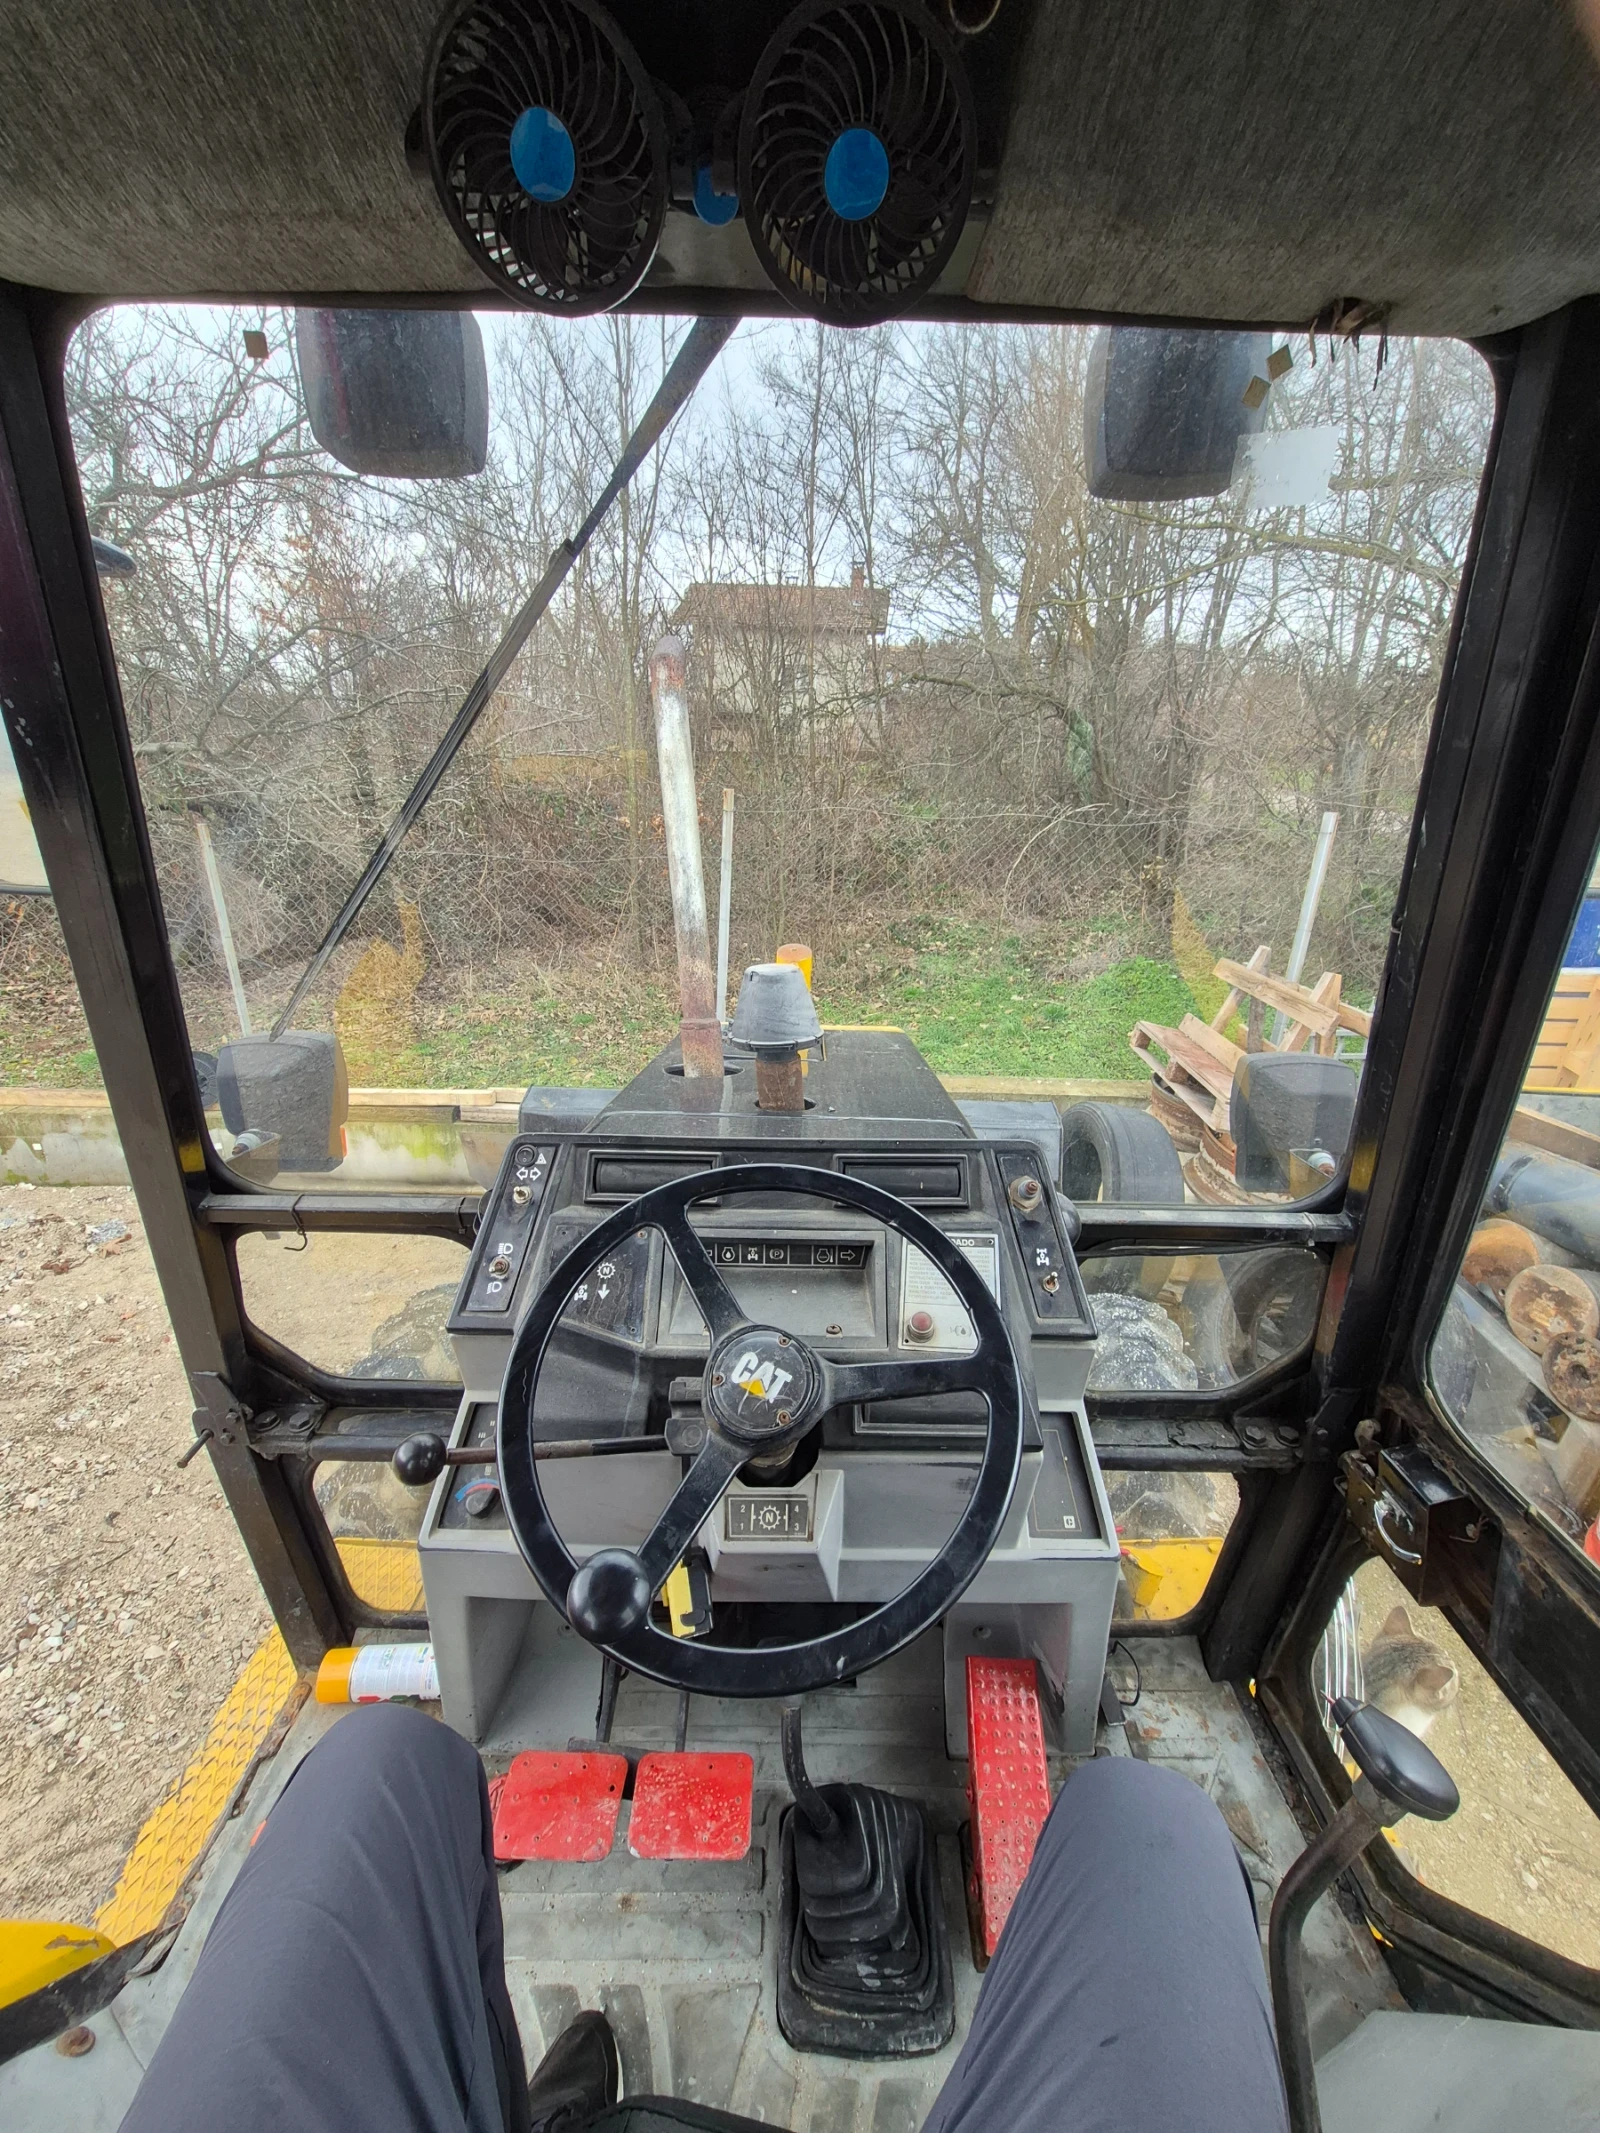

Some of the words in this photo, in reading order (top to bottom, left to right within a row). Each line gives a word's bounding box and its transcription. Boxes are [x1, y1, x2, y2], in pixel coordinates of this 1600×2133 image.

[731, 1351, 793, 1403] CAT
[740, 1504, 746, 1513] 2
[794, 1504, 799, 1513] 4
[765, 1512, 774, 1523] N
[740, 1522, 744, 1531] 1
[794, 1523, 799, 1531] 3
